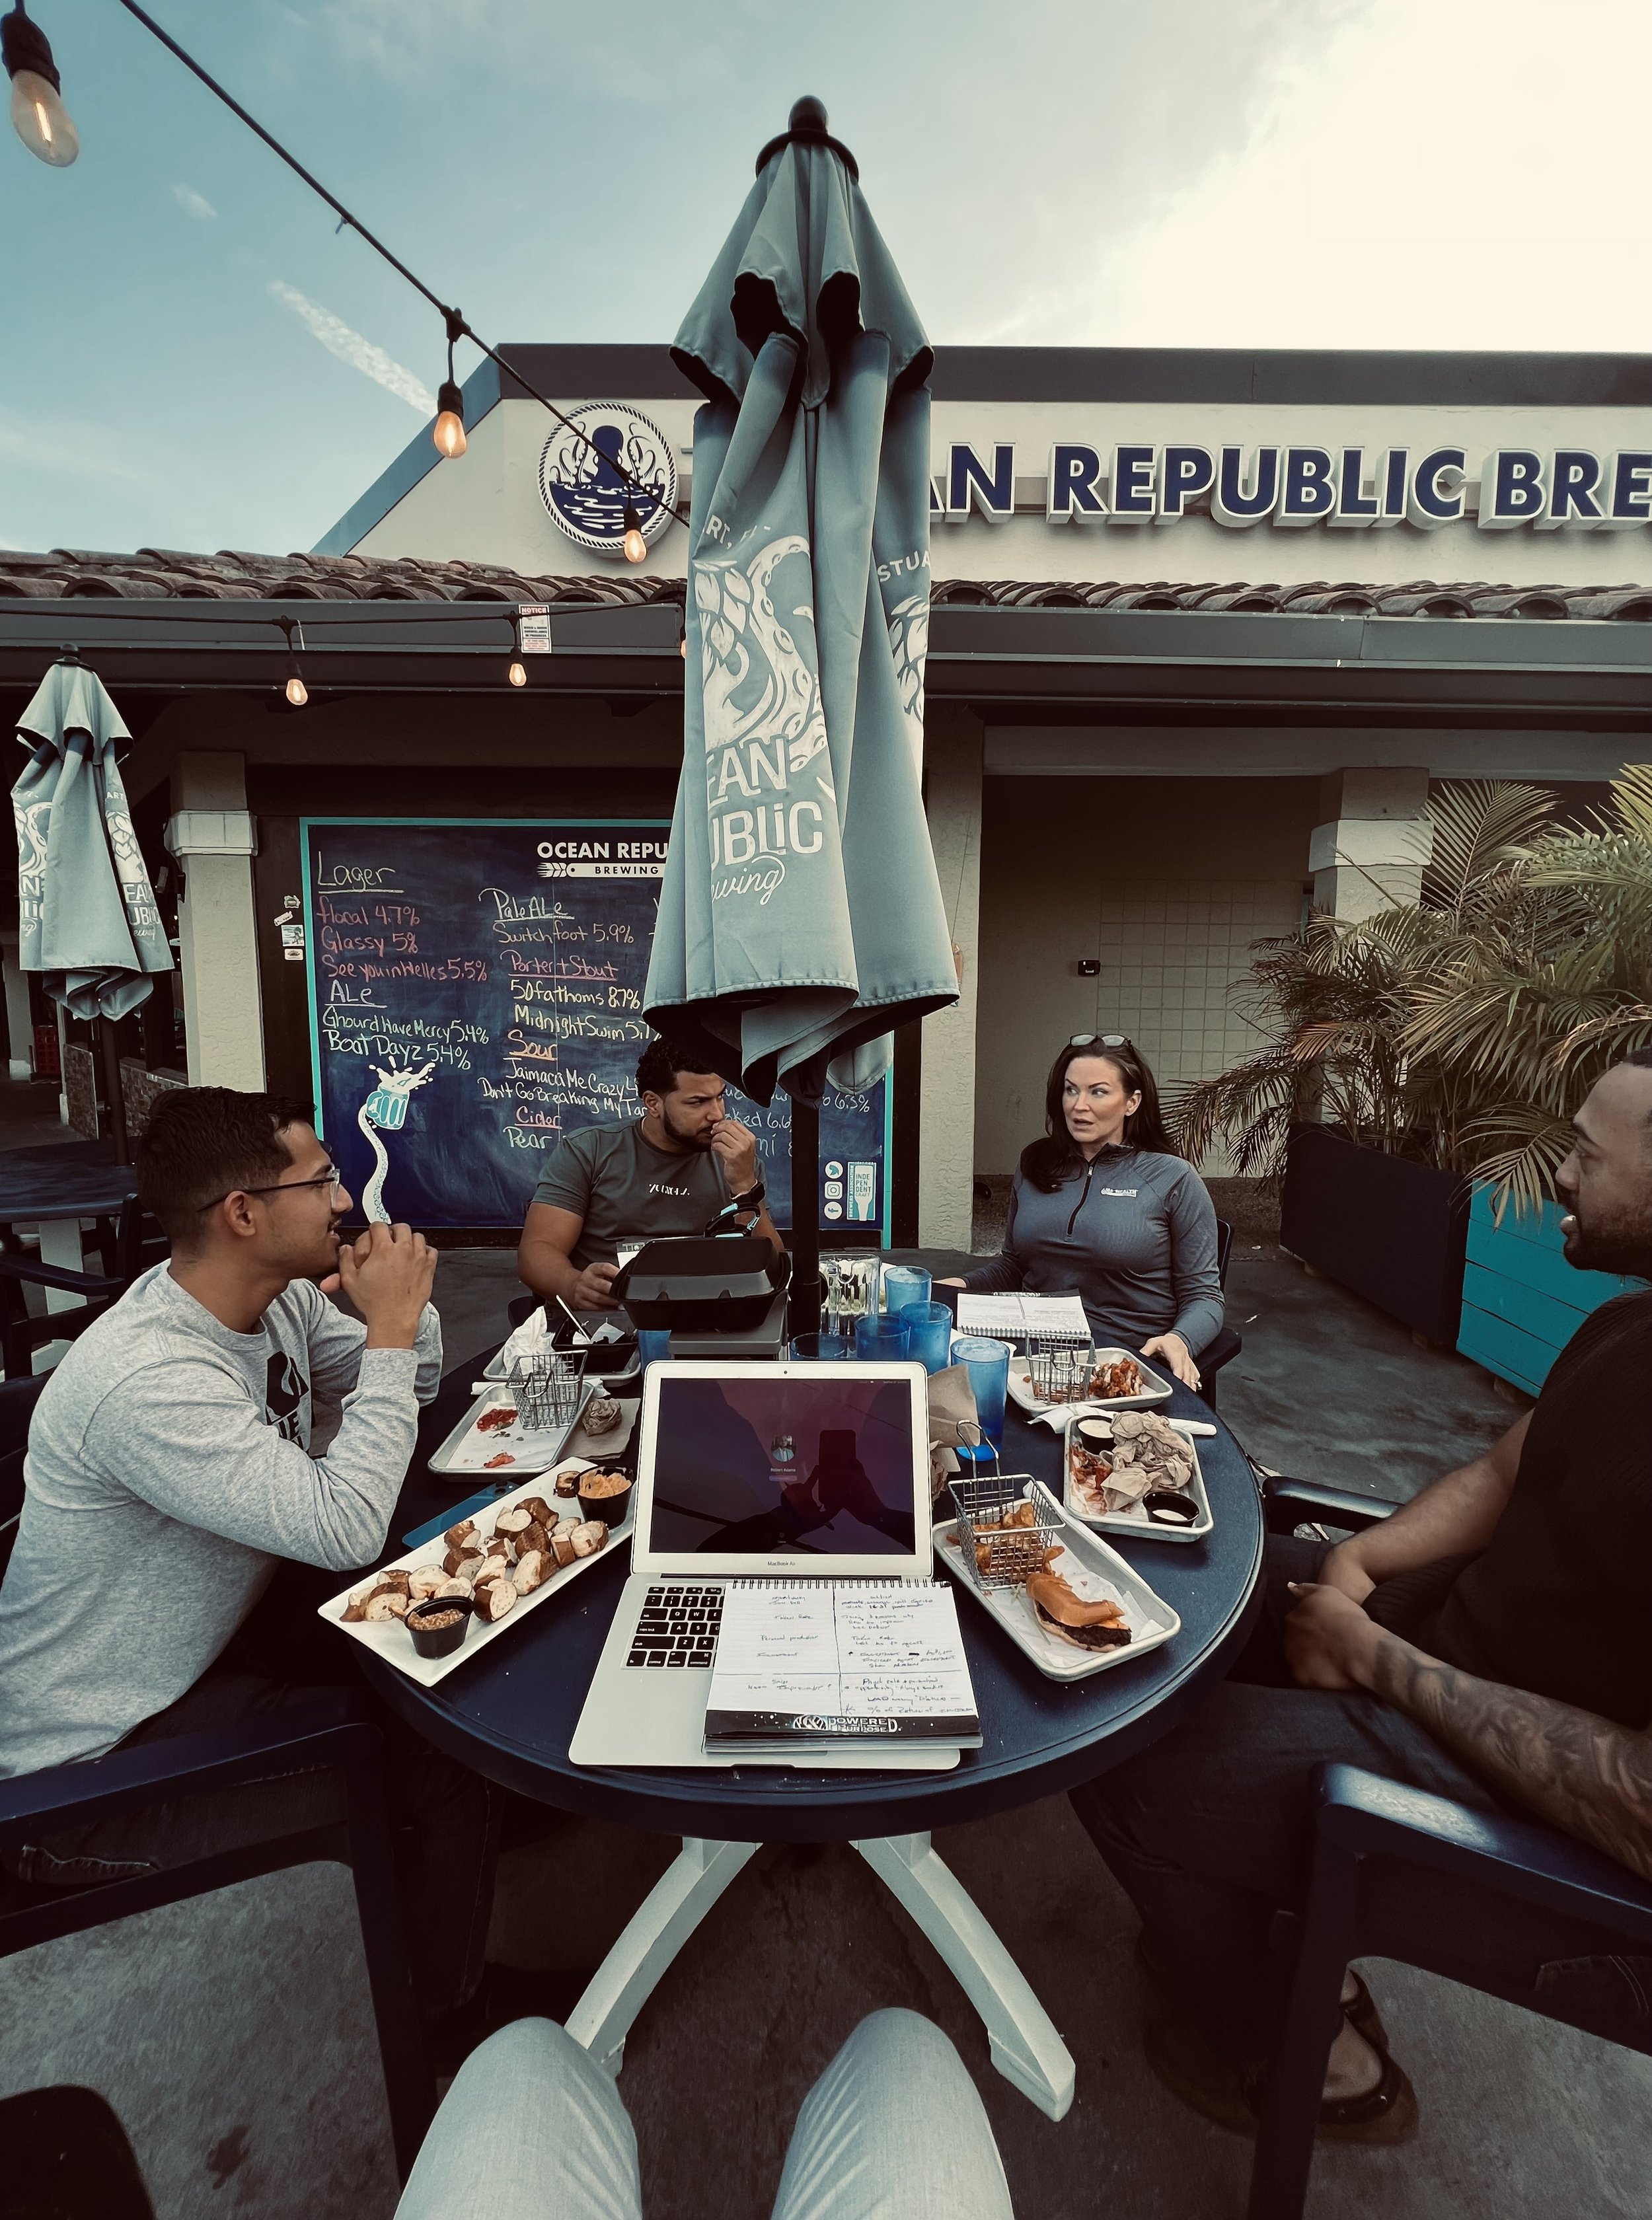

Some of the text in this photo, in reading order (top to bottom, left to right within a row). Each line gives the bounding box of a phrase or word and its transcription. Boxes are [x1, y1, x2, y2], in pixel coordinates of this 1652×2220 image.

[1051, 442, 1467, 521] REPUBLIC
[1491, 447, 1652, 520] BRE
[537, 842, 668, 858] OCEAN REPU
[317, 850, 396, 892] Lager
[595, 866, 659, 875] BREWING
[375, 906, 420, 926] 4.7%
[478, 887, 527, 920] Pale
[321, 925, 384, 957] Glassy
[392, 932, 418, 953] 5%
[593, 923, 634, 944] 5.9%
[322, 954, 357, 978] See
[447, 957, 488, 982] 5.5%
[500, 949, 552, 973] Porter
[570, 955, 619, 979] Stout
[608, 986, 641, 1010] 8.7%
[414, 1019, 451, 1044] Mercy
[450, 1019, 490, 1045] 5.4%
[514, 1003, 586, 1039] Midnight
[583, 1015, 625, 1042] Swim
[322, 1029, 372, 1056] Boat
[427, 1042, 471, 1070] 5.4%
[507, 1029, 558, 1058] Sour
[566, 1068, 587, 1090] Me
[588, 1073, 624, 1102] Crazy
[515, 1082, 534, 1102] Go
[533, 1088, 599, 1114] Breaking
[603, 1097, 623, 1119] My
[515, 1105, 560, 1126] Cider
[503, 1125, 553, 1149] Pear
